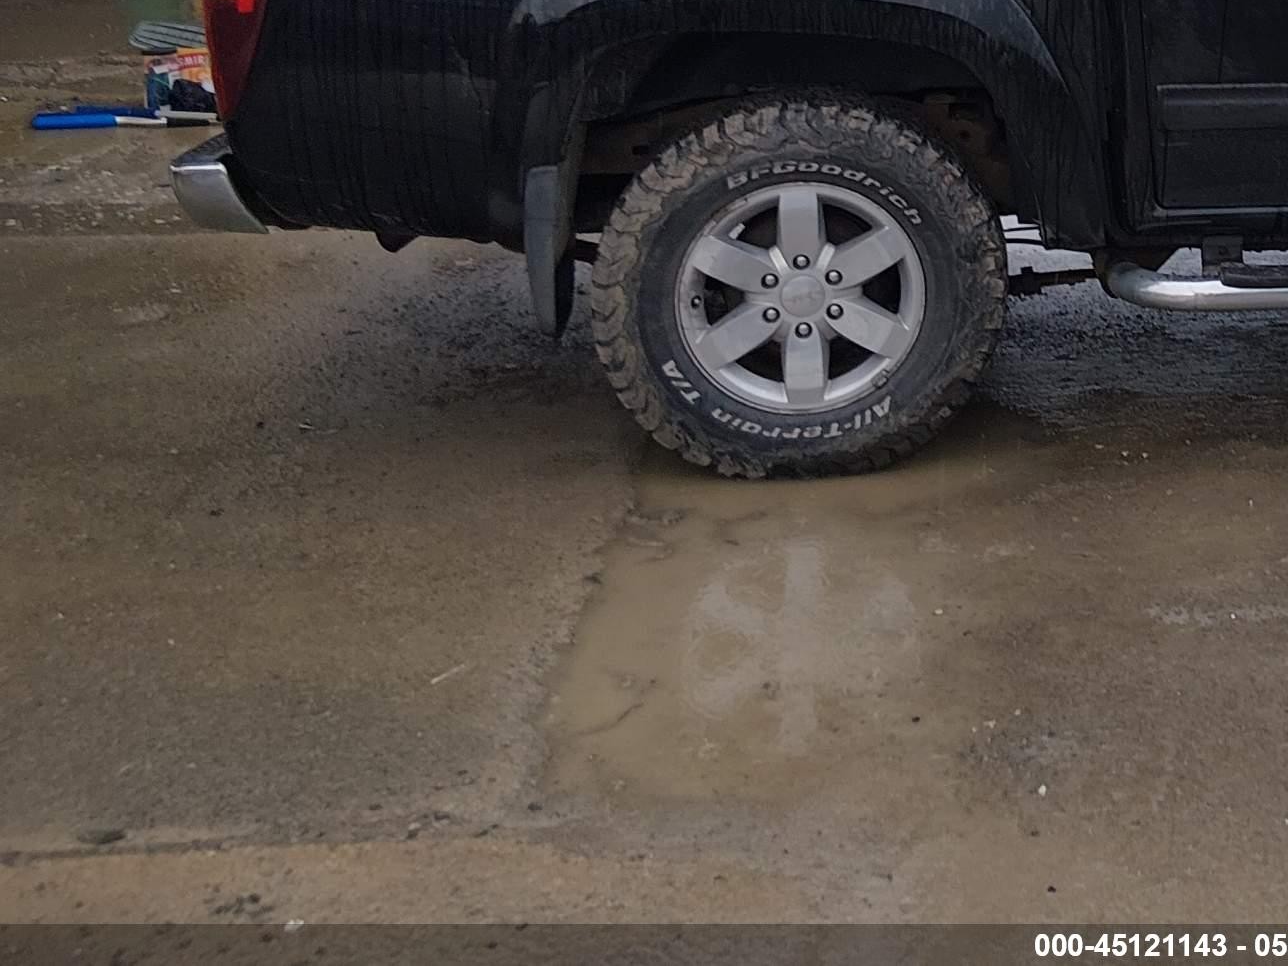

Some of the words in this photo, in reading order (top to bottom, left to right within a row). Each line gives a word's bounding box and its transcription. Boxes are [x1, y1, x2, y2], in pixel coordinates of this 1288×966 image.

[727, 160, 922, 225] BFGoodrich
[661, 359, 701, 405] T/A
[711, 395, 892, 439] All-Terrain
